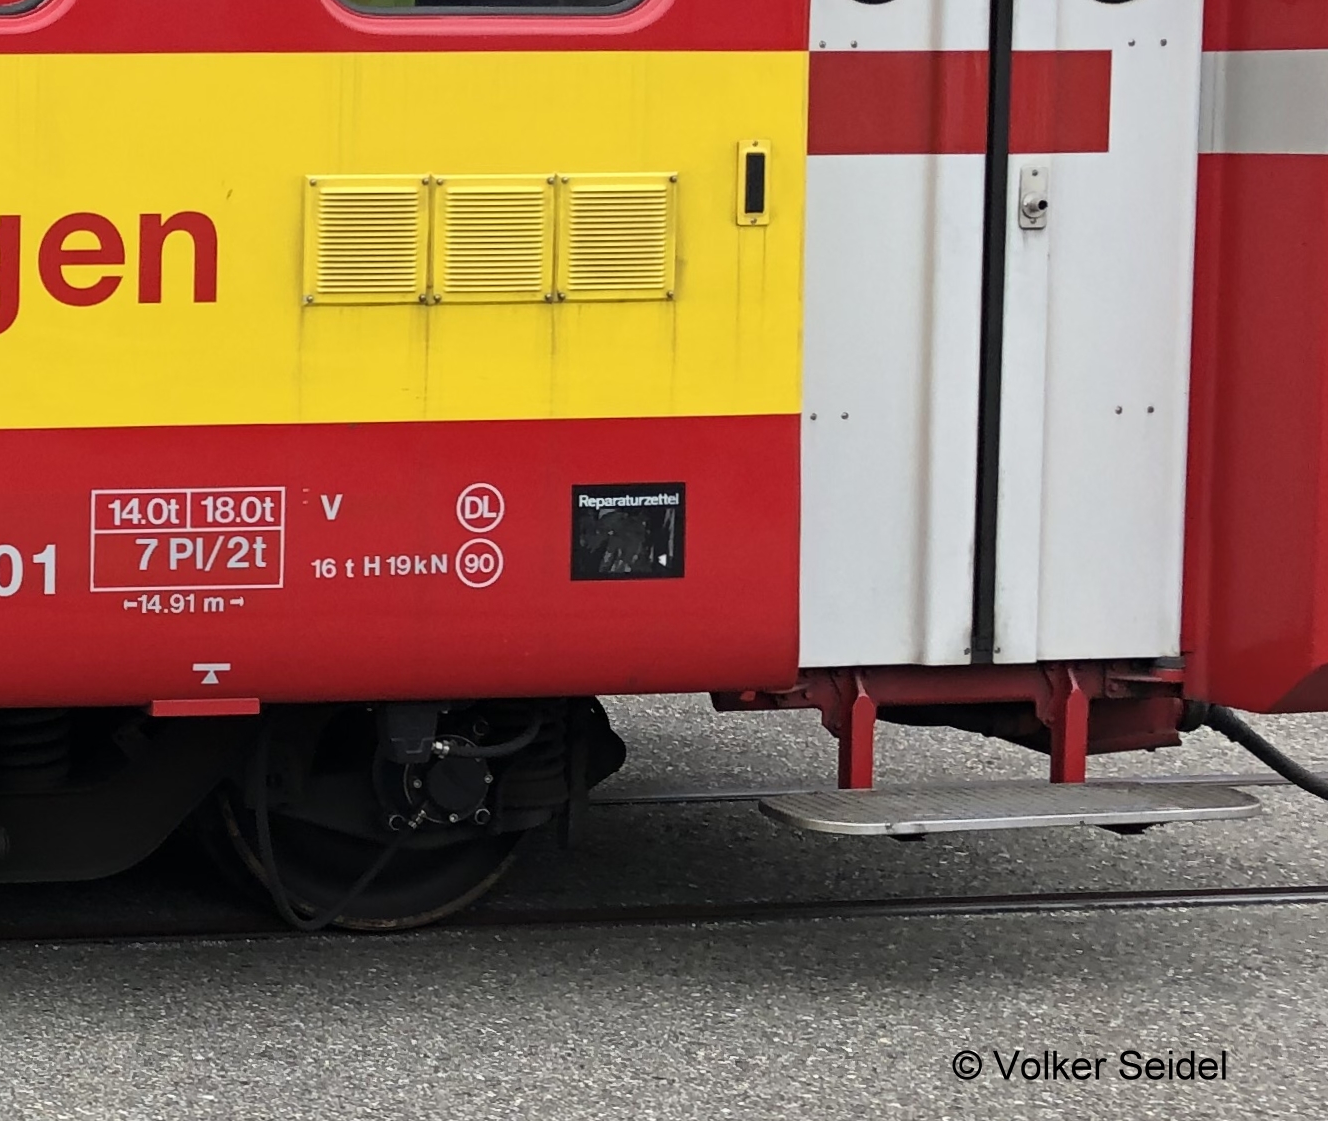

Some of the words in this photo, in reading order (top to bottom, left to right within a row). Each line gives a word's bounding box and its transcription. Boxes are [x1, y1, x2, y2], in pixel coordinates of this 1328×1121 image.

[108, 498, 180, 526] 14.0t
[201, 496, 275, 523] 18.0t
[321, 493, 344, 521] V
[464, 495, 497, 520] DL
[578, 493, 680, 510] Reparaturzettel
[135, 538, 159, 570] 7
[464, 553, 494, 574] 90
[311, 558, 337, 578] 16
[345, 558, 355, 578] t
[137, 593, 195, 614] 14.91
[203, 596, 225, 612] m
